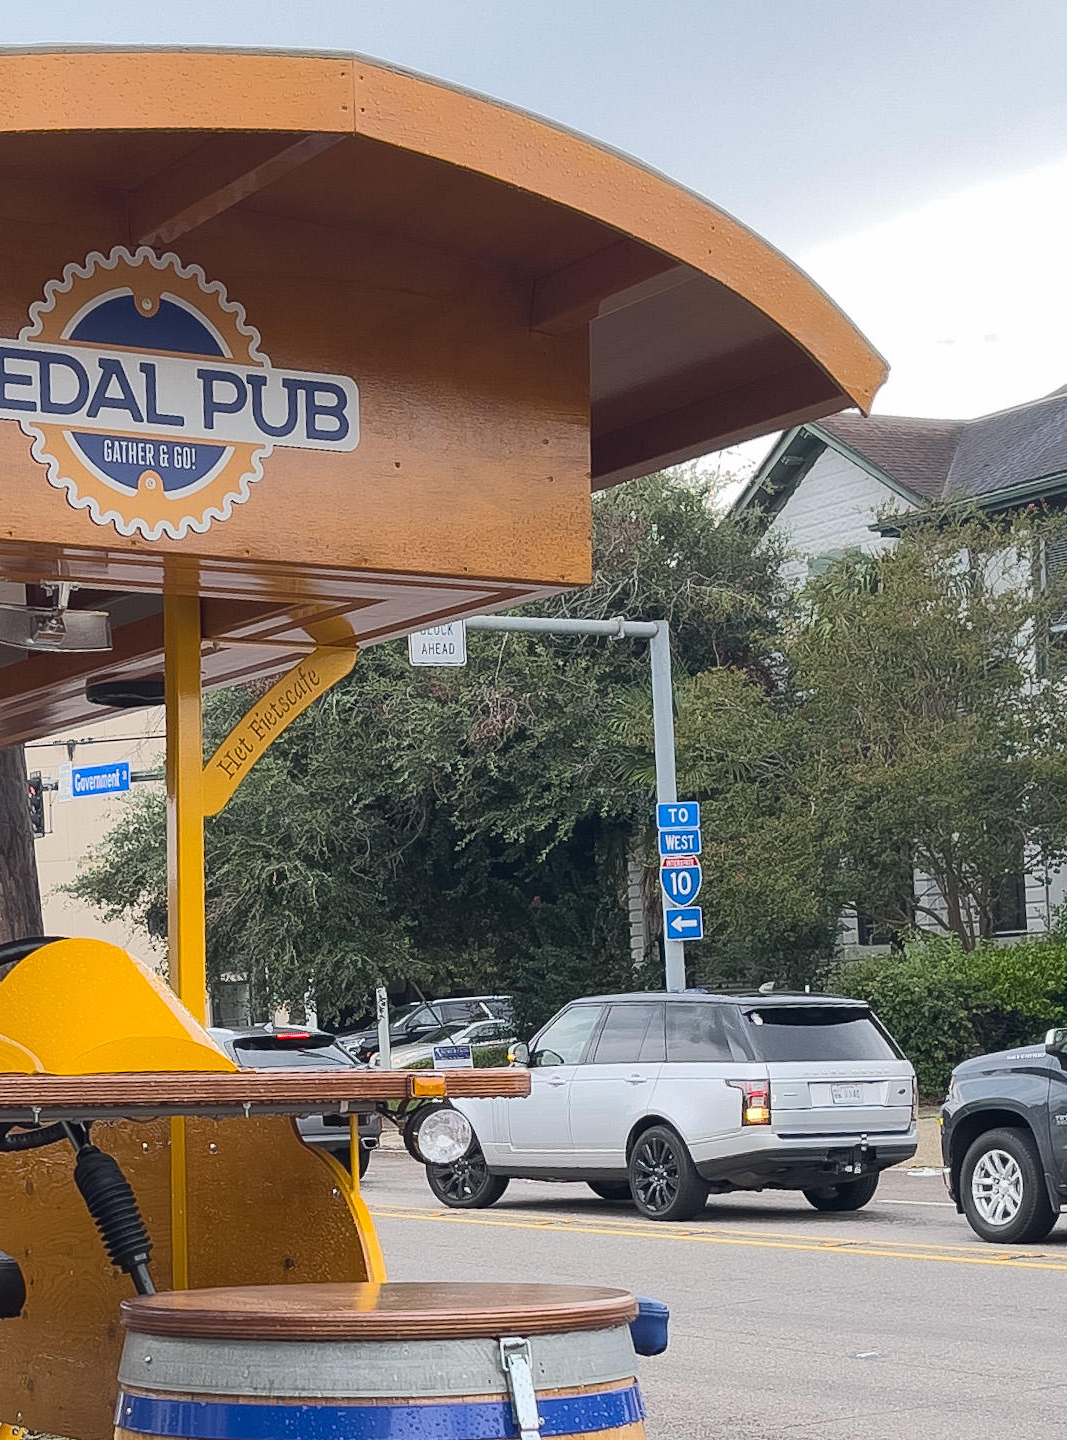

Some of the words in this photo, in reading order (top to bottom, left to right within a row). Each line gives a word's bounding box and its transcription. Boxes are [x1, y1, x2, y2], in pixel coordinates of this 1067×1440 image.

[197, 368, 350, 441] PUB
[103, 439, 156, 466] GATHER
[159, 445, 169, 468] &
[174, 446, 197, 470] GO!
[421, 643, 455, 655] AHEAD
[216, 736, 254, 780] Het
[247, 667, 322, 742] Fietscafe
[74, 769, 121, 793] Government
[667, 808, 690, 824] TO
[664, 834, 694, 850] WEST
[669, 870, 692, 896] 10
